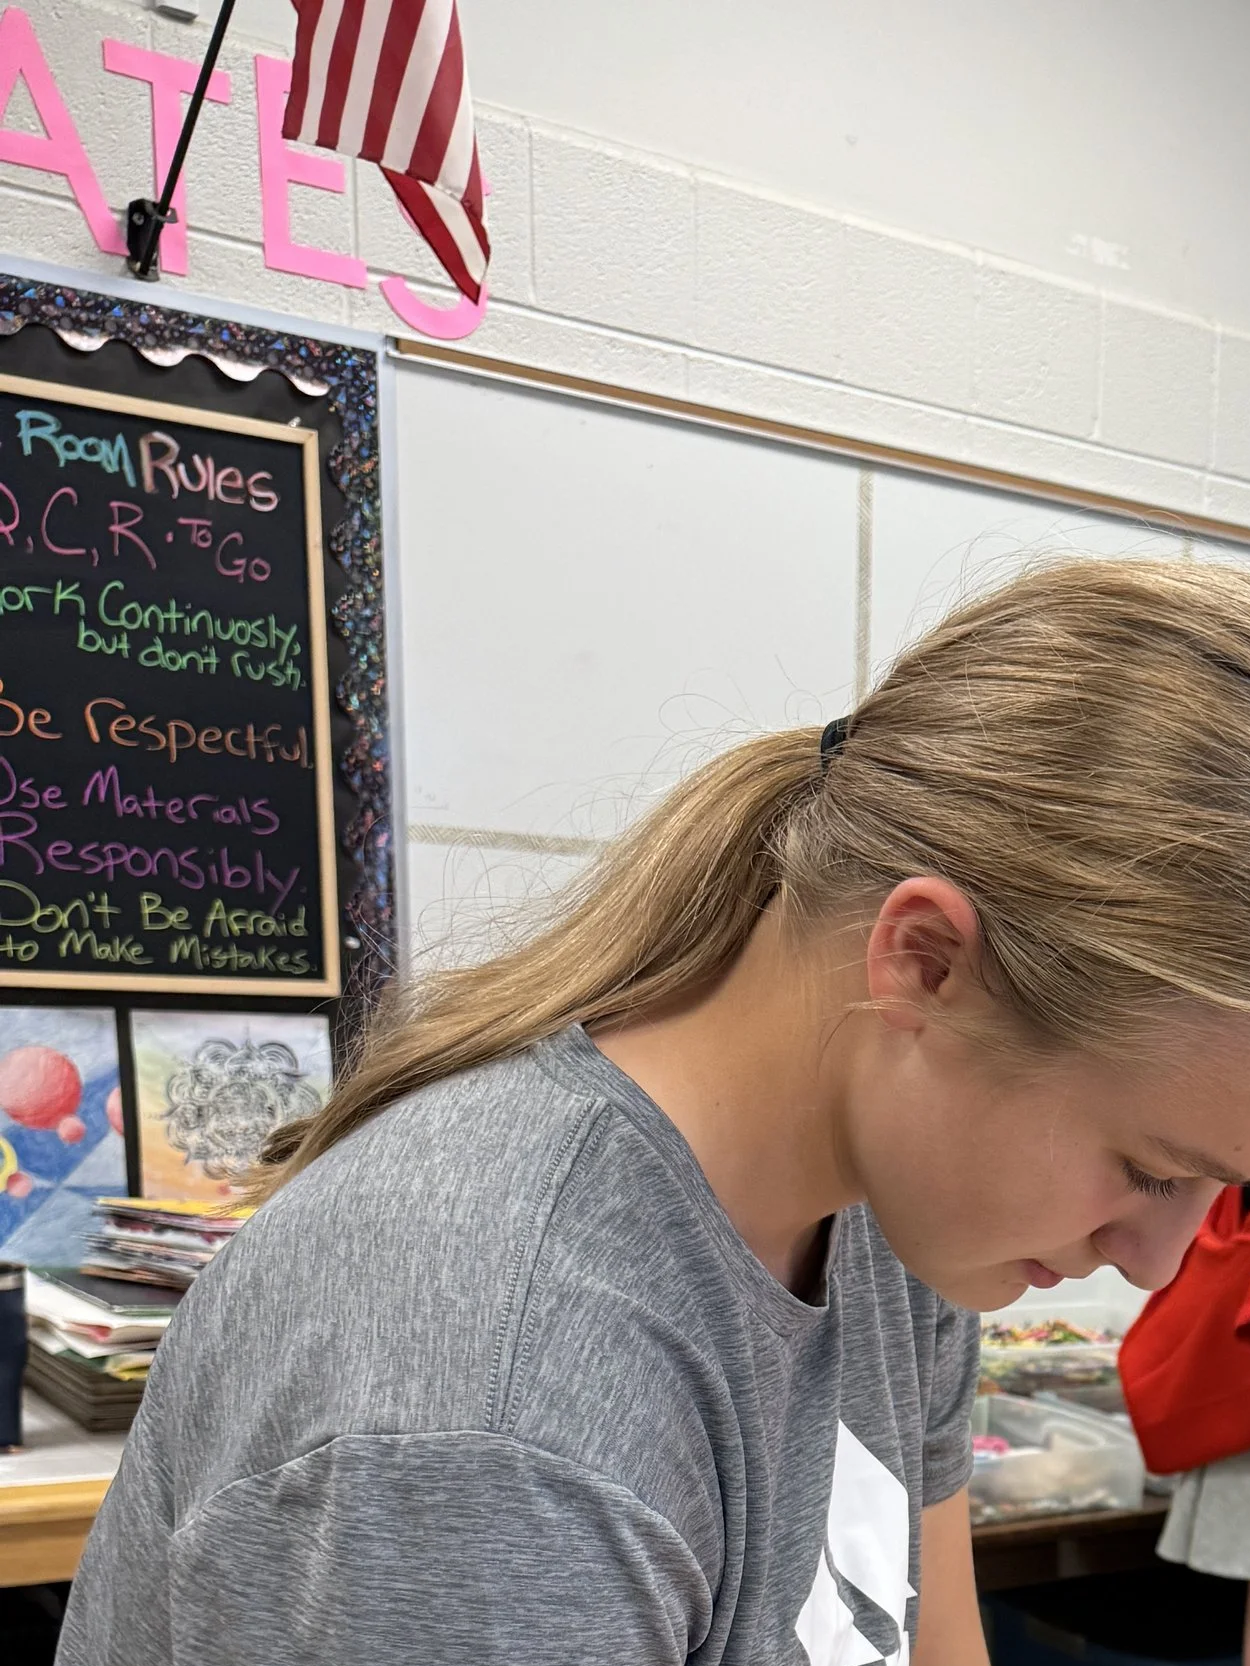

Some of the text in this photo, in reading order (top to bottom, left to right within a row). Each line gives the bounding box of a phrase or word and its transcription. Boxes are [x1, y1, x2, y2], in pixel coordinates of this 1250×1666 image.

[0, 7, 490, 339] ATE
[139, 432, 280, 512] Rules
[215, 532, 271, 583] Go
[0, 578, 85, 616] ork
[77, 618, 131, 659] but
[140, 891, 192, 930] Be
[0, 934, 39, 961] to
